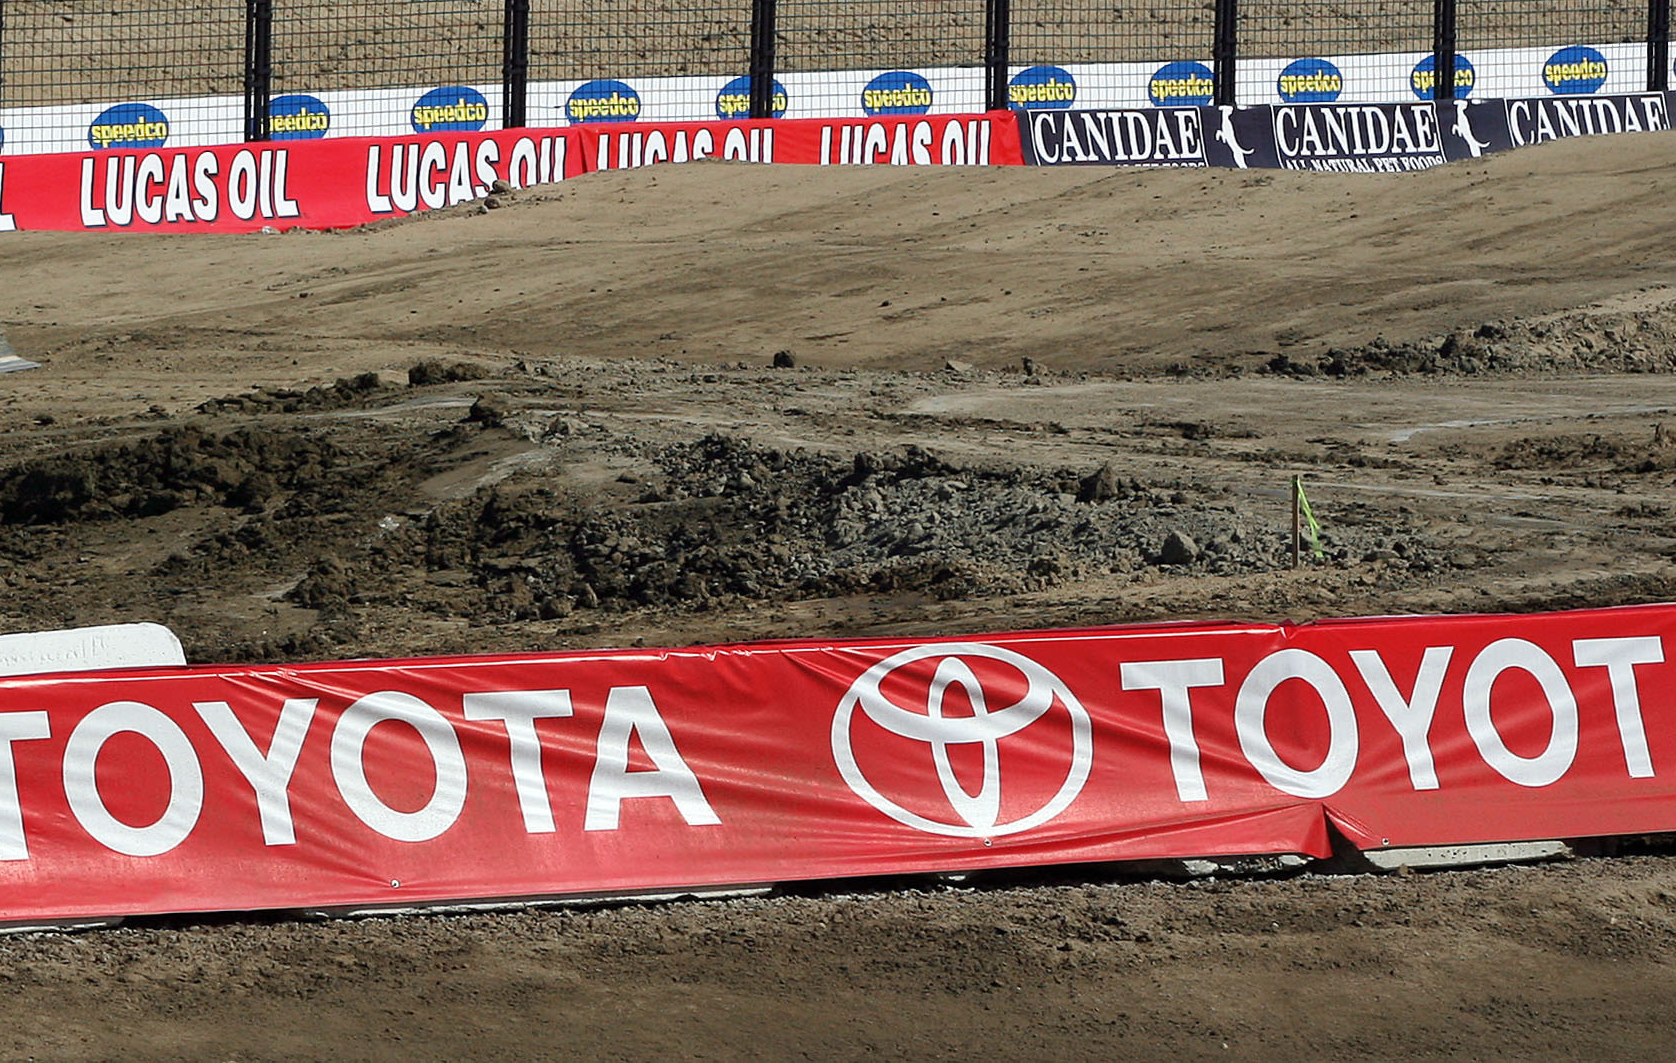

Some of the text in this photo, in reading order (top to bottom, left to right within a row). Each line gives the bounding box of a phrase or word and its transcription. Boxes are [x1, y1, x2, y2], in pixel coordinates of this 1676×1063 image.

[1150, 73, 1214, 100] speedco
[1281, 70, 1342, 96] speedco
[1546, 58, 1607, 87] speedco
[568, 91, 640, 122] speedco
[864, 83, 932, 112] speedco
[1009, 78, 1073, 106] speedco
[413, 97, 486, 127] speedco
[1508, 96, 1667, 147] CANIDAE
[90, 115, 168, 146] speedco
[1034, 110, 1202, 164] CANIDAE
[1275, 104, 1442, 157] CANIDAE
[366, 139, 501, 214] LUCAS
[1310, 157, 1375, 173] NATURAL
[1373, 156, 1403, 173] PET
[79, 149, 300, 228] LUCAS OIL
